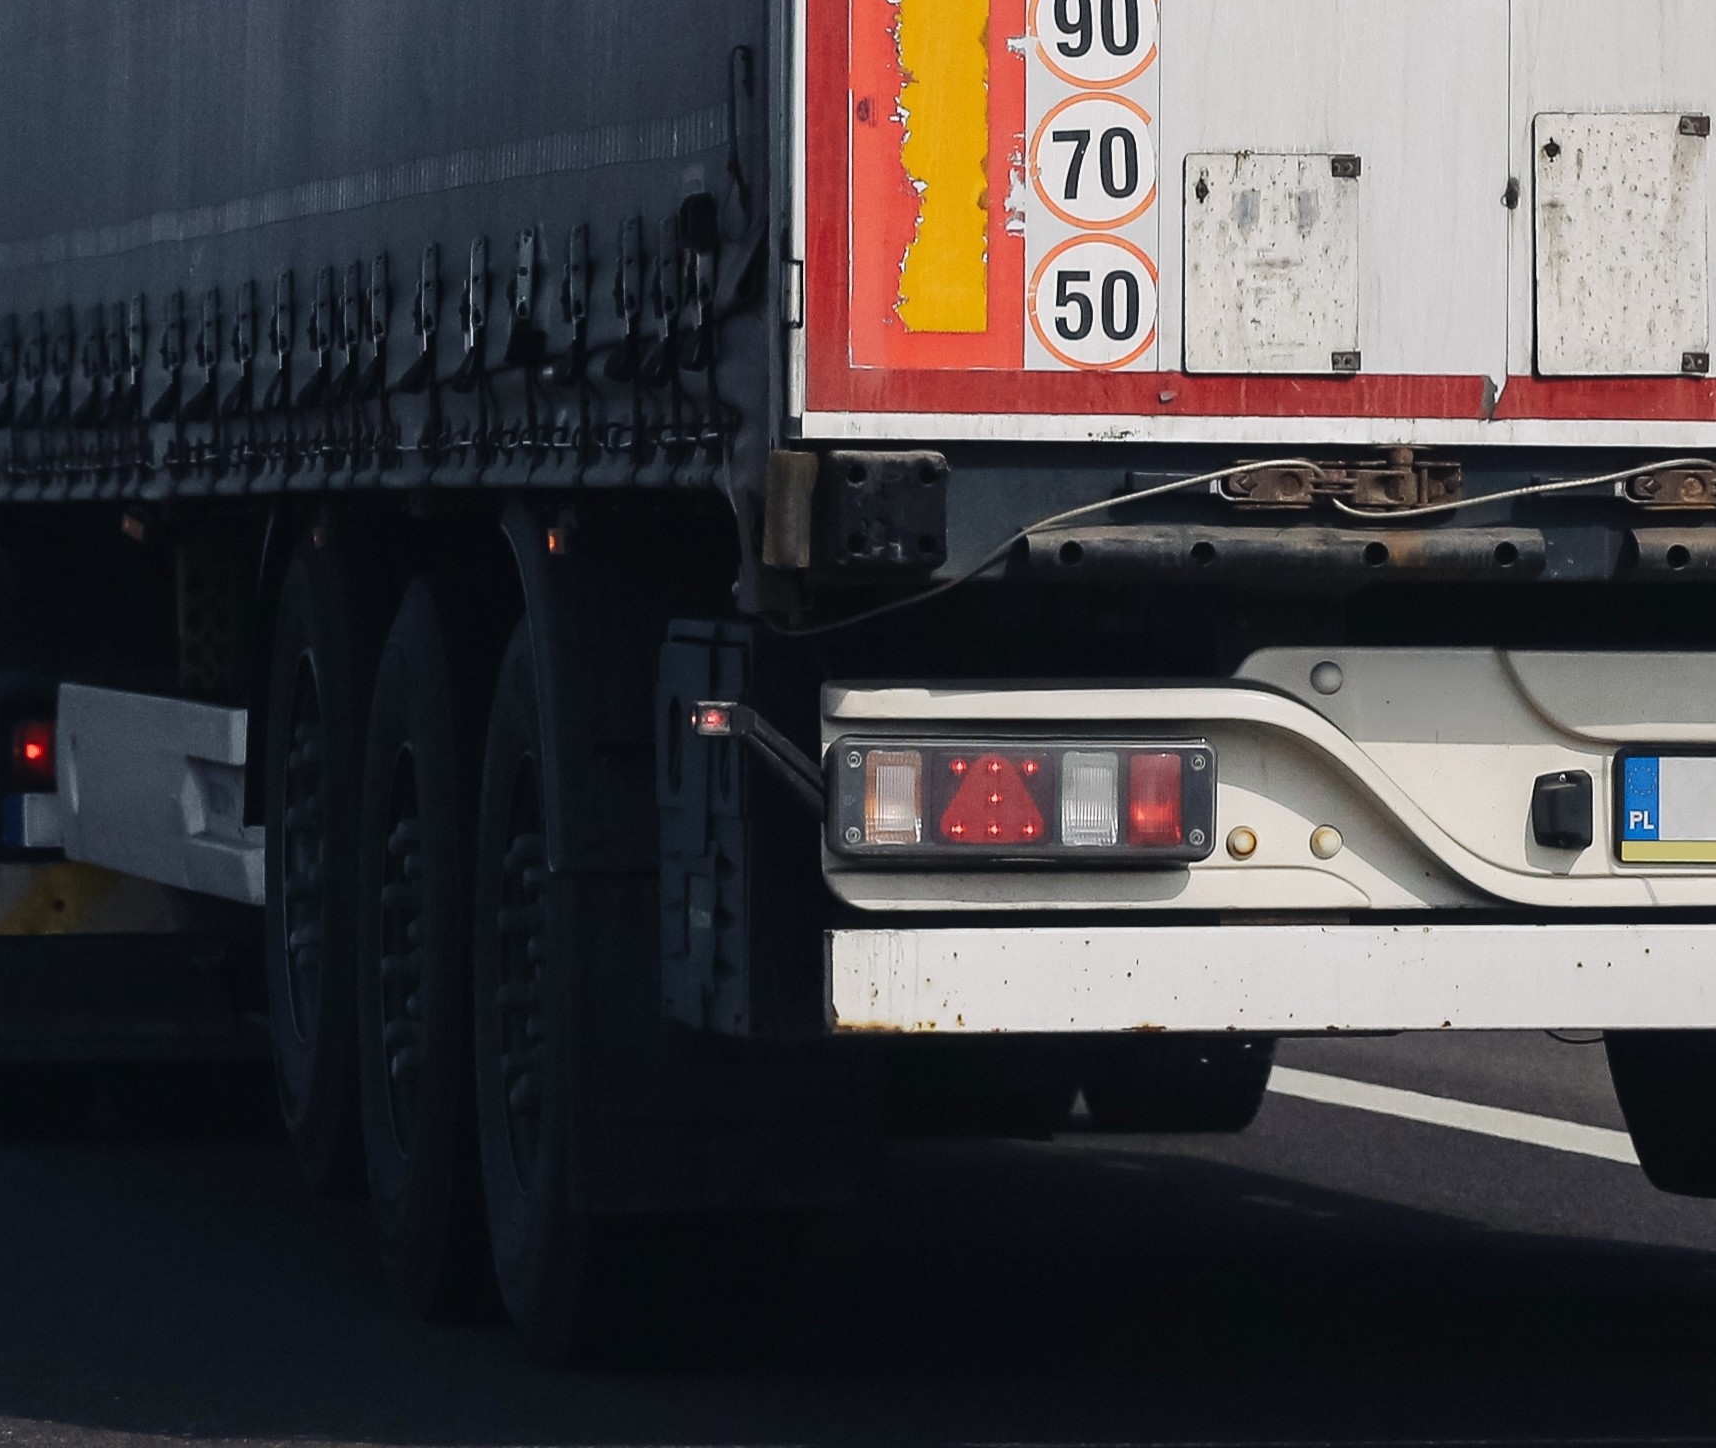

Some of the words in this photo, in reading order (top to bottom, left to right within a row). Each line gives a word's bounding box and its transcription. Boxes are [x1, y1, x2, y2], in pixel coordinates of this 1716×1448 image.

[1052, 126, 1139, 200] 70
[1054, 269, 1140, 341] 50
[1629, 810, 1655, 830] PL
